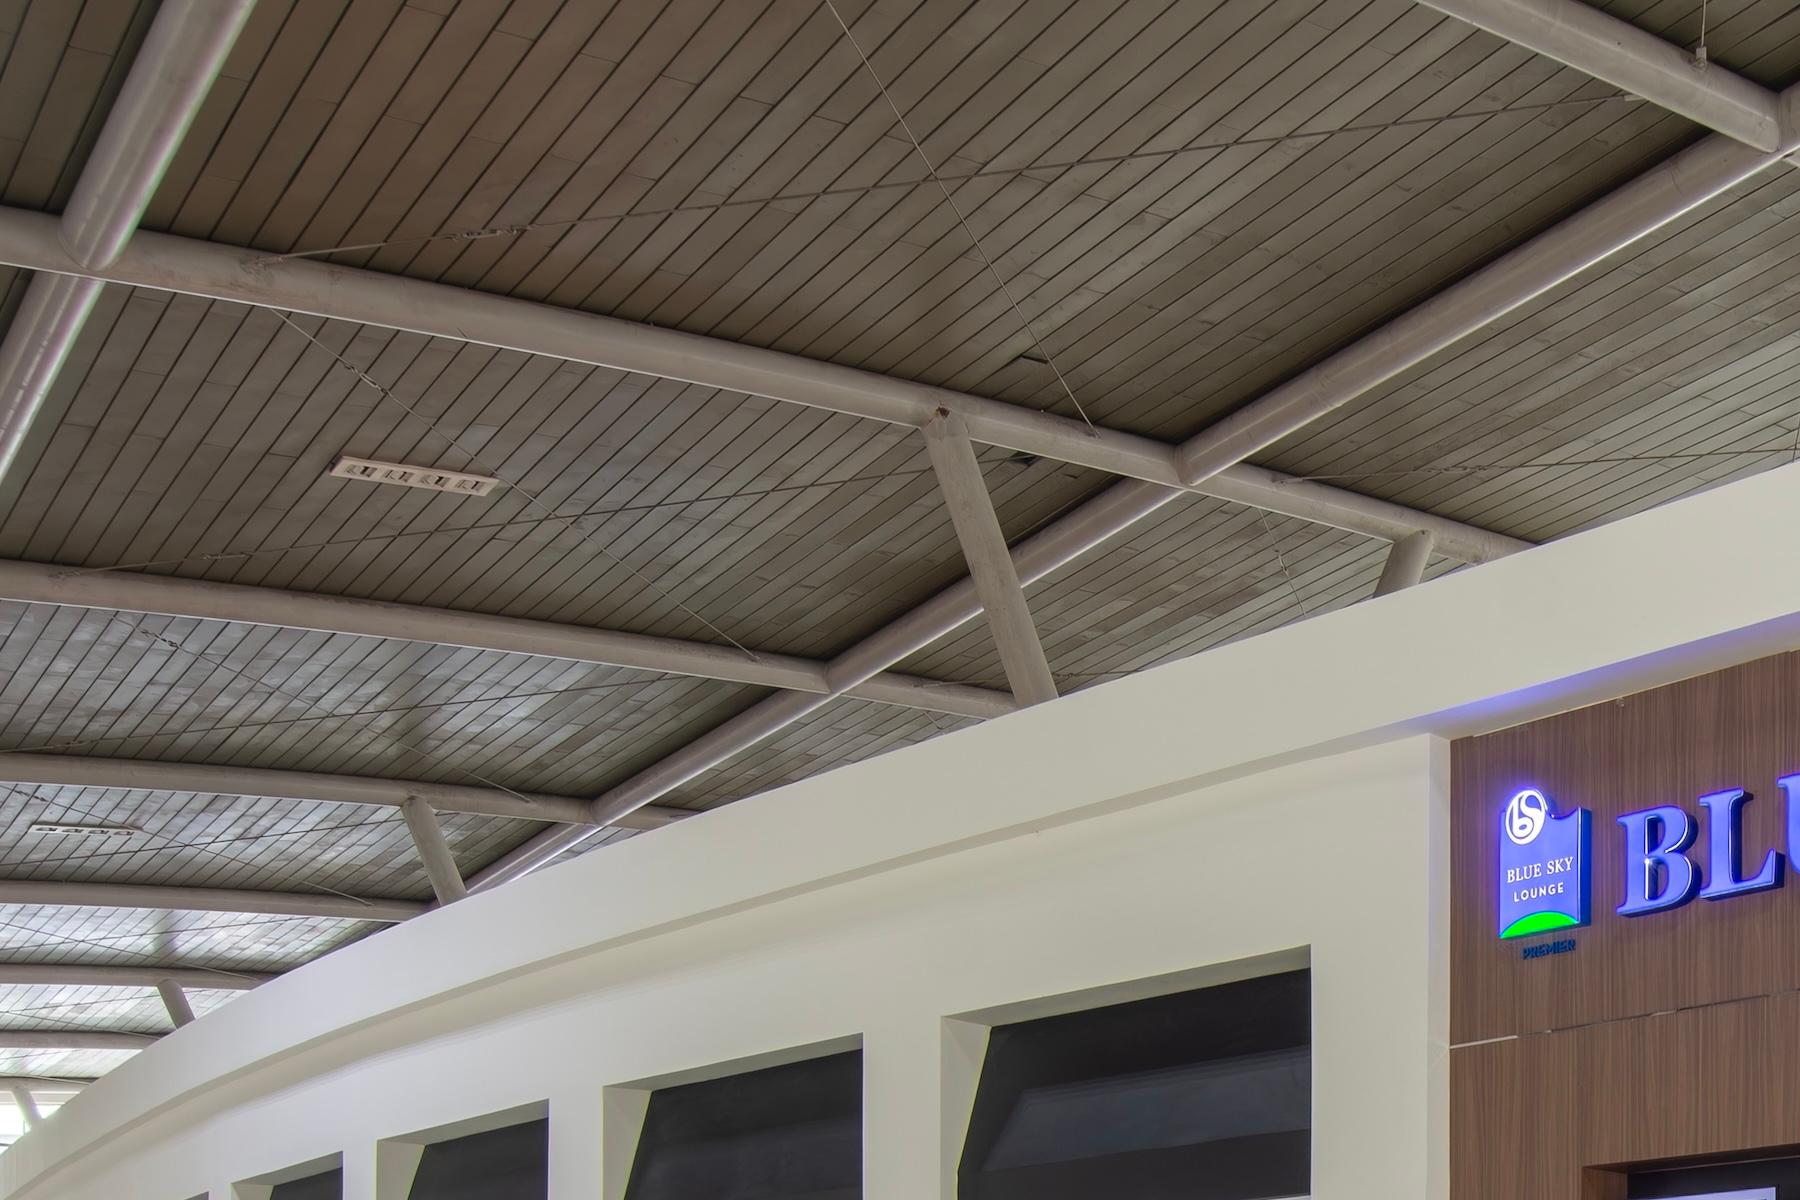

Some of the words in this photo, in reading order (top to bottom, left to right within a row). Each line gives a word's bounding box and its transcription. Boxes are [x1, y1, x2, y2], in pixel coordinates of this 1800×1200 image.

[1506, 863, 1542, 884] BLUE
[1546, 856, 1574, 875] SKY
[1513, 882, 1565, 903] LOUNGE
[1522, 938, 1577, 960] PREMIER
